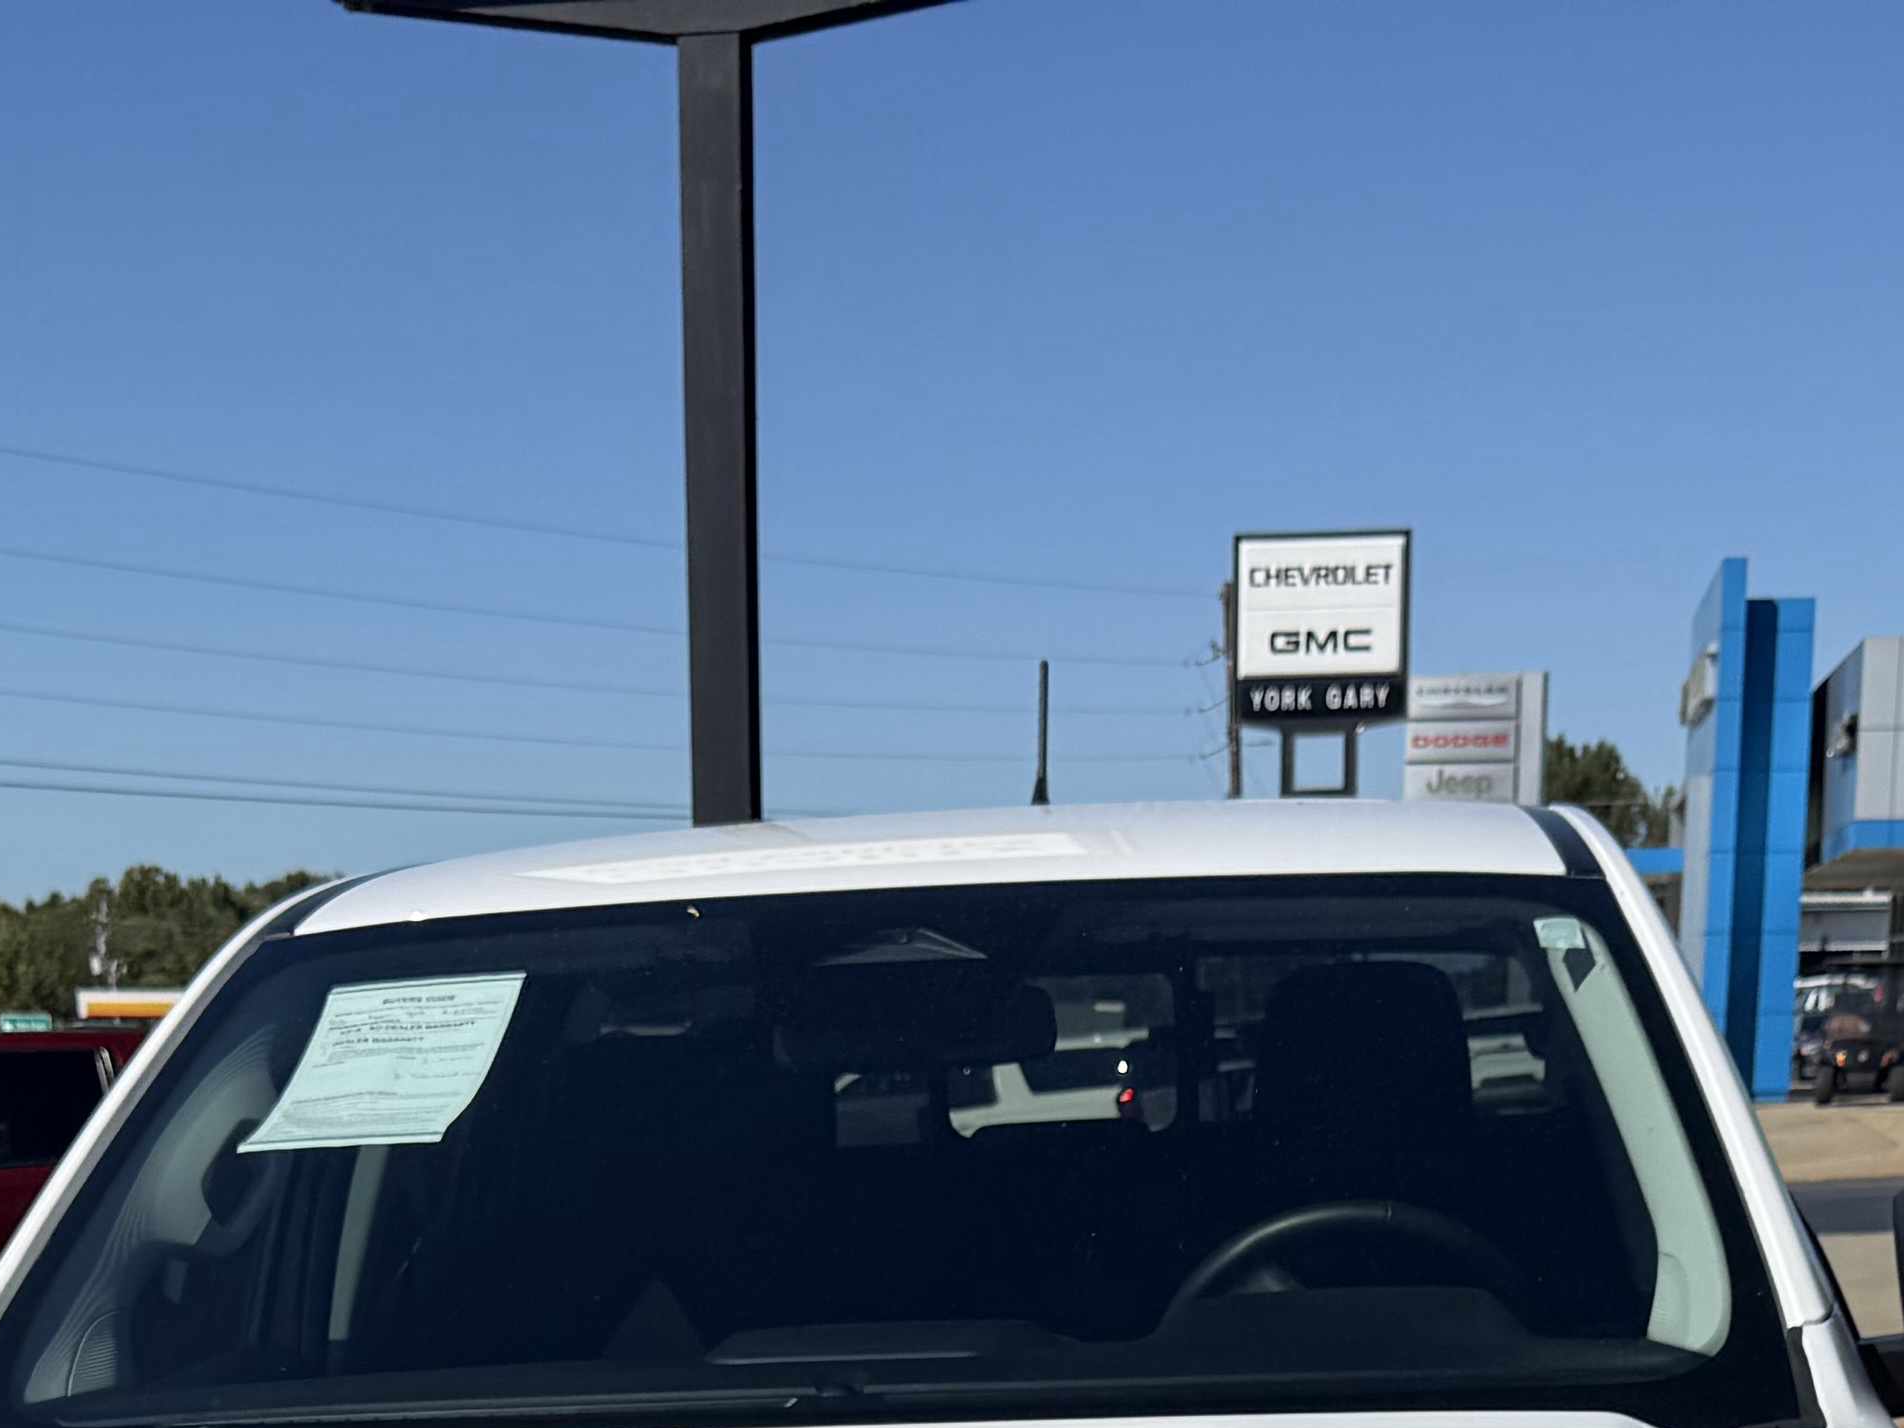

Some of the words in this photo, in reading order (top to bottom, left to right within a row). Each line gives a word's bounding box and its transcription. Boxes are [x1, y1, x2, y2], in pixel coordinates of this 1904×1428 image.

[1249, 564, 1392, 588] CHEVROLET
[1270, 629, 1372, 655] GMC
[1250, 683, 1313, 712] YORK
[1325, 682, 1390, 710] GARY
[1426, 769, 1493, 799] Jeep
